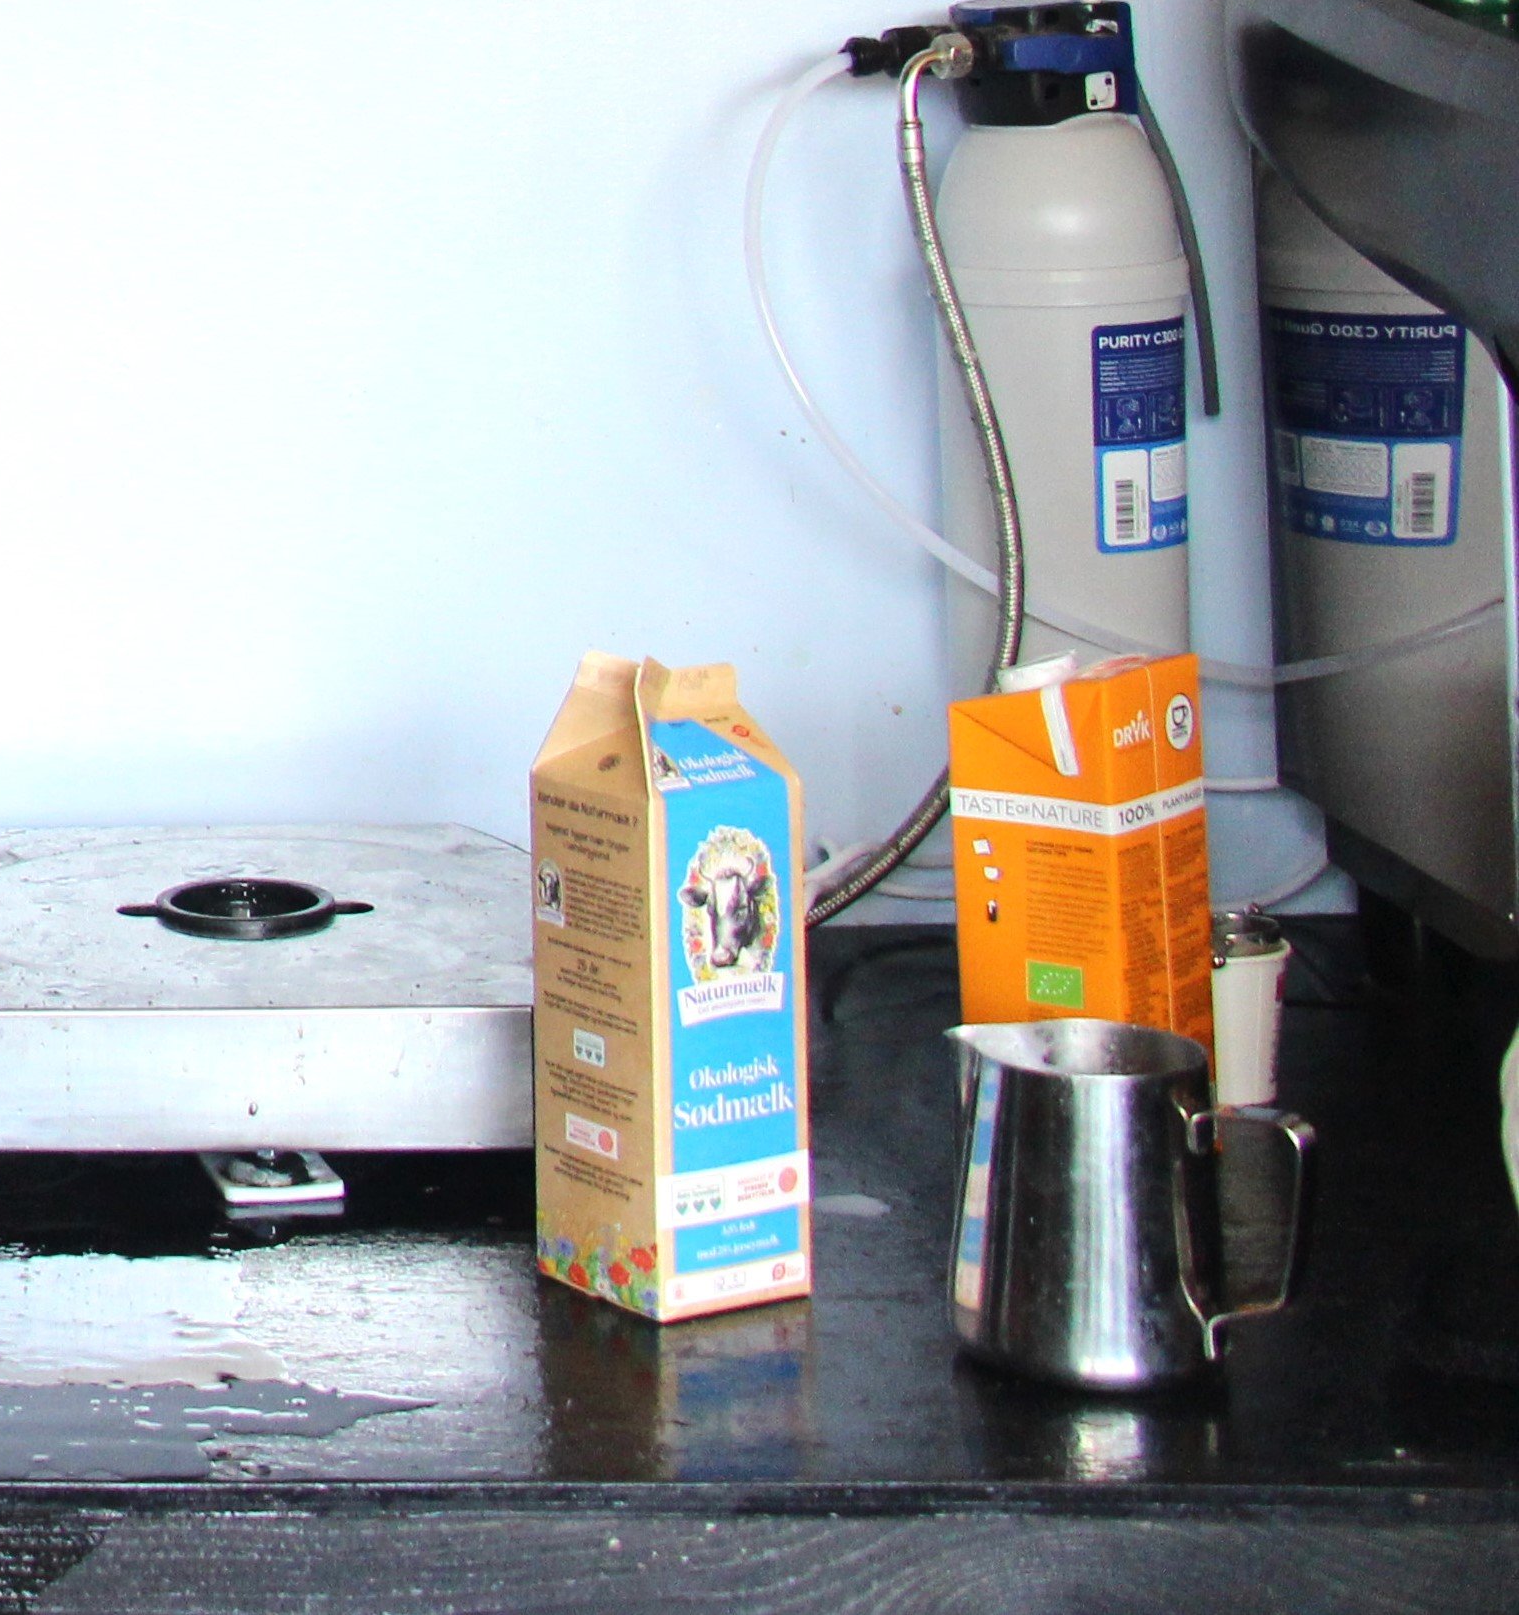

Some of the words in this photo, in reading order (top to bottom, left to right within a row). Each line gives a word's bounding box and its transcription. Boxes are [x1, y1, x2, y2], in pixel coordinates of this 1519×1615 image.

[1098, 333, 1151, 349] PURITY
[1153, 328, 1178, 345] C300
[1113, 709, 1153, 749] DRYK
[957, 794, 1015, 816] TASTE
[1031, 802, 1103, 828] NATURE
[1119, 801, 1155, 826] 100%
[684, 974, 778, 1008] Naturmælk
[688, 1053, 779, 1090] Økologisk
